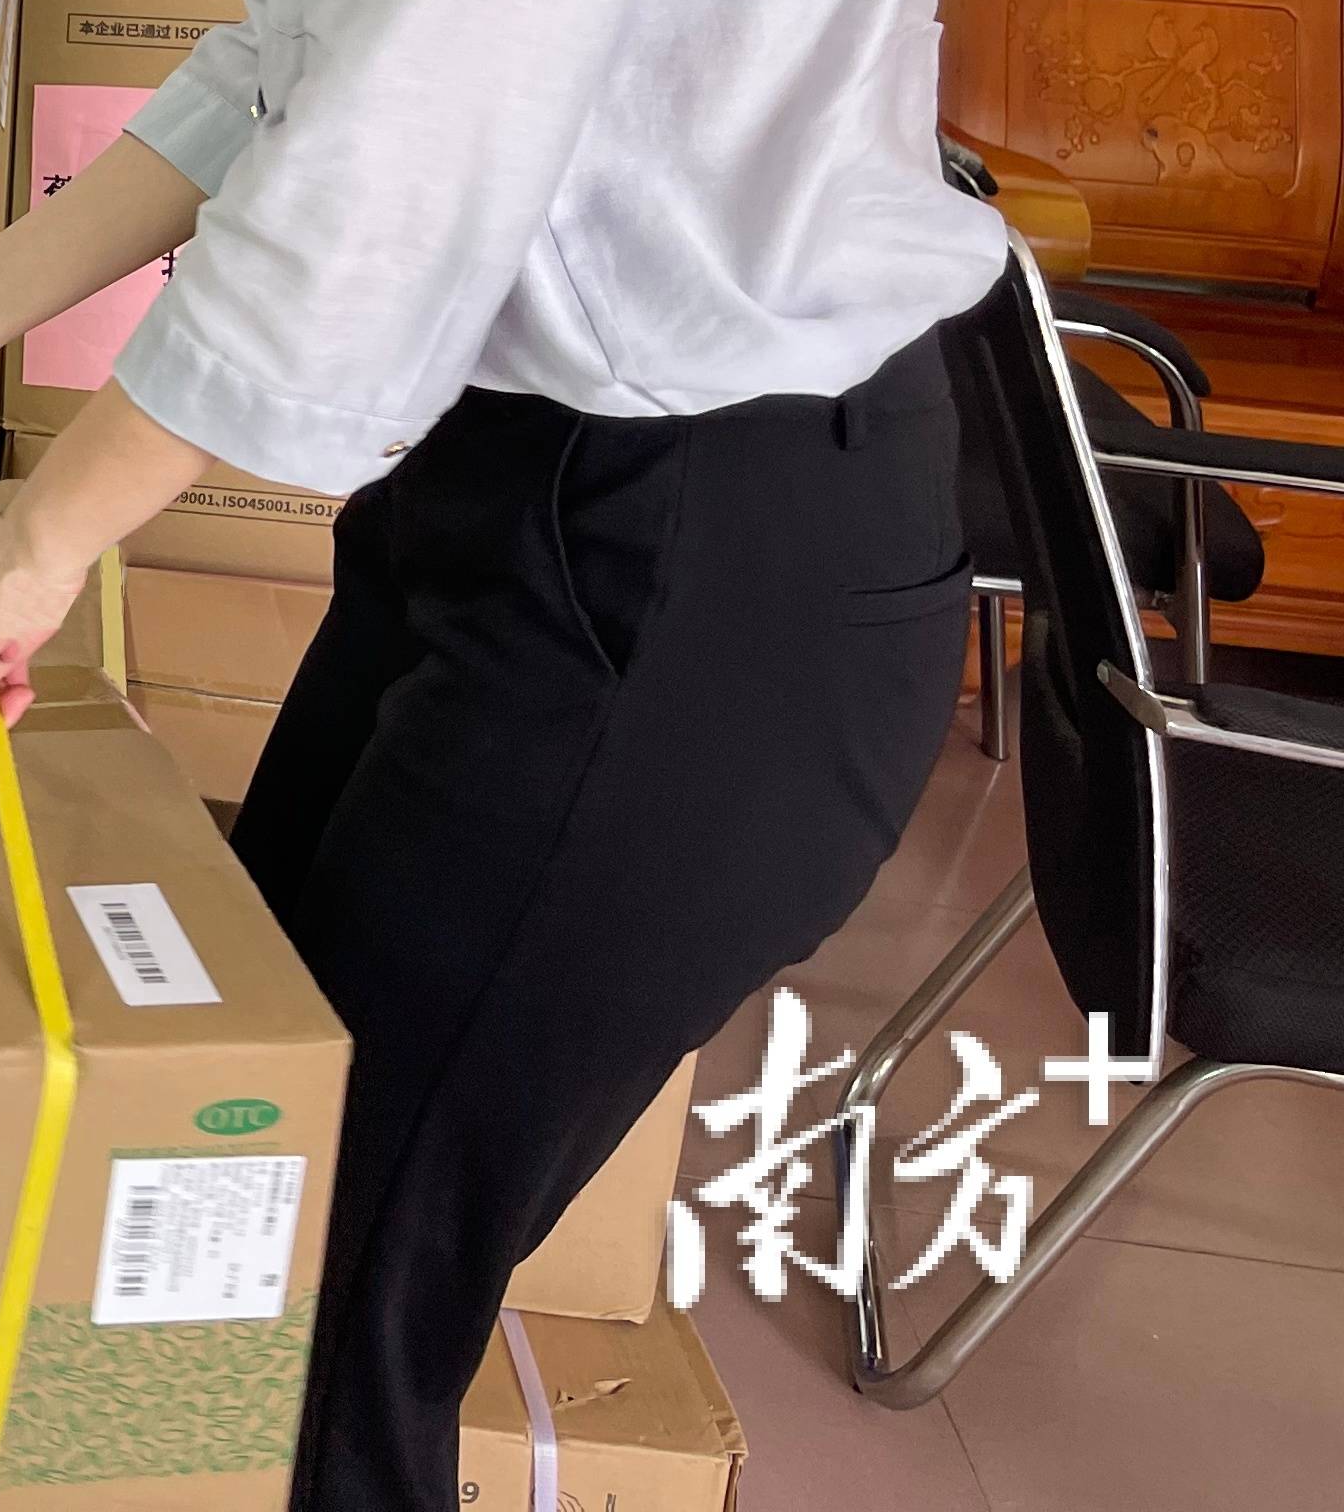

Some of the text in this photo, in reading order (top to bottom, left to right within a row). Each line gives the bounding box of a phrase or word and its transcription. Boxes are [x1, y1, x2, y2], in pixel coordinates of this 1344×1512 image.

[79, 20, 171, 39] 本企业已通过
[200, 1105, 276, 1129] OTC
